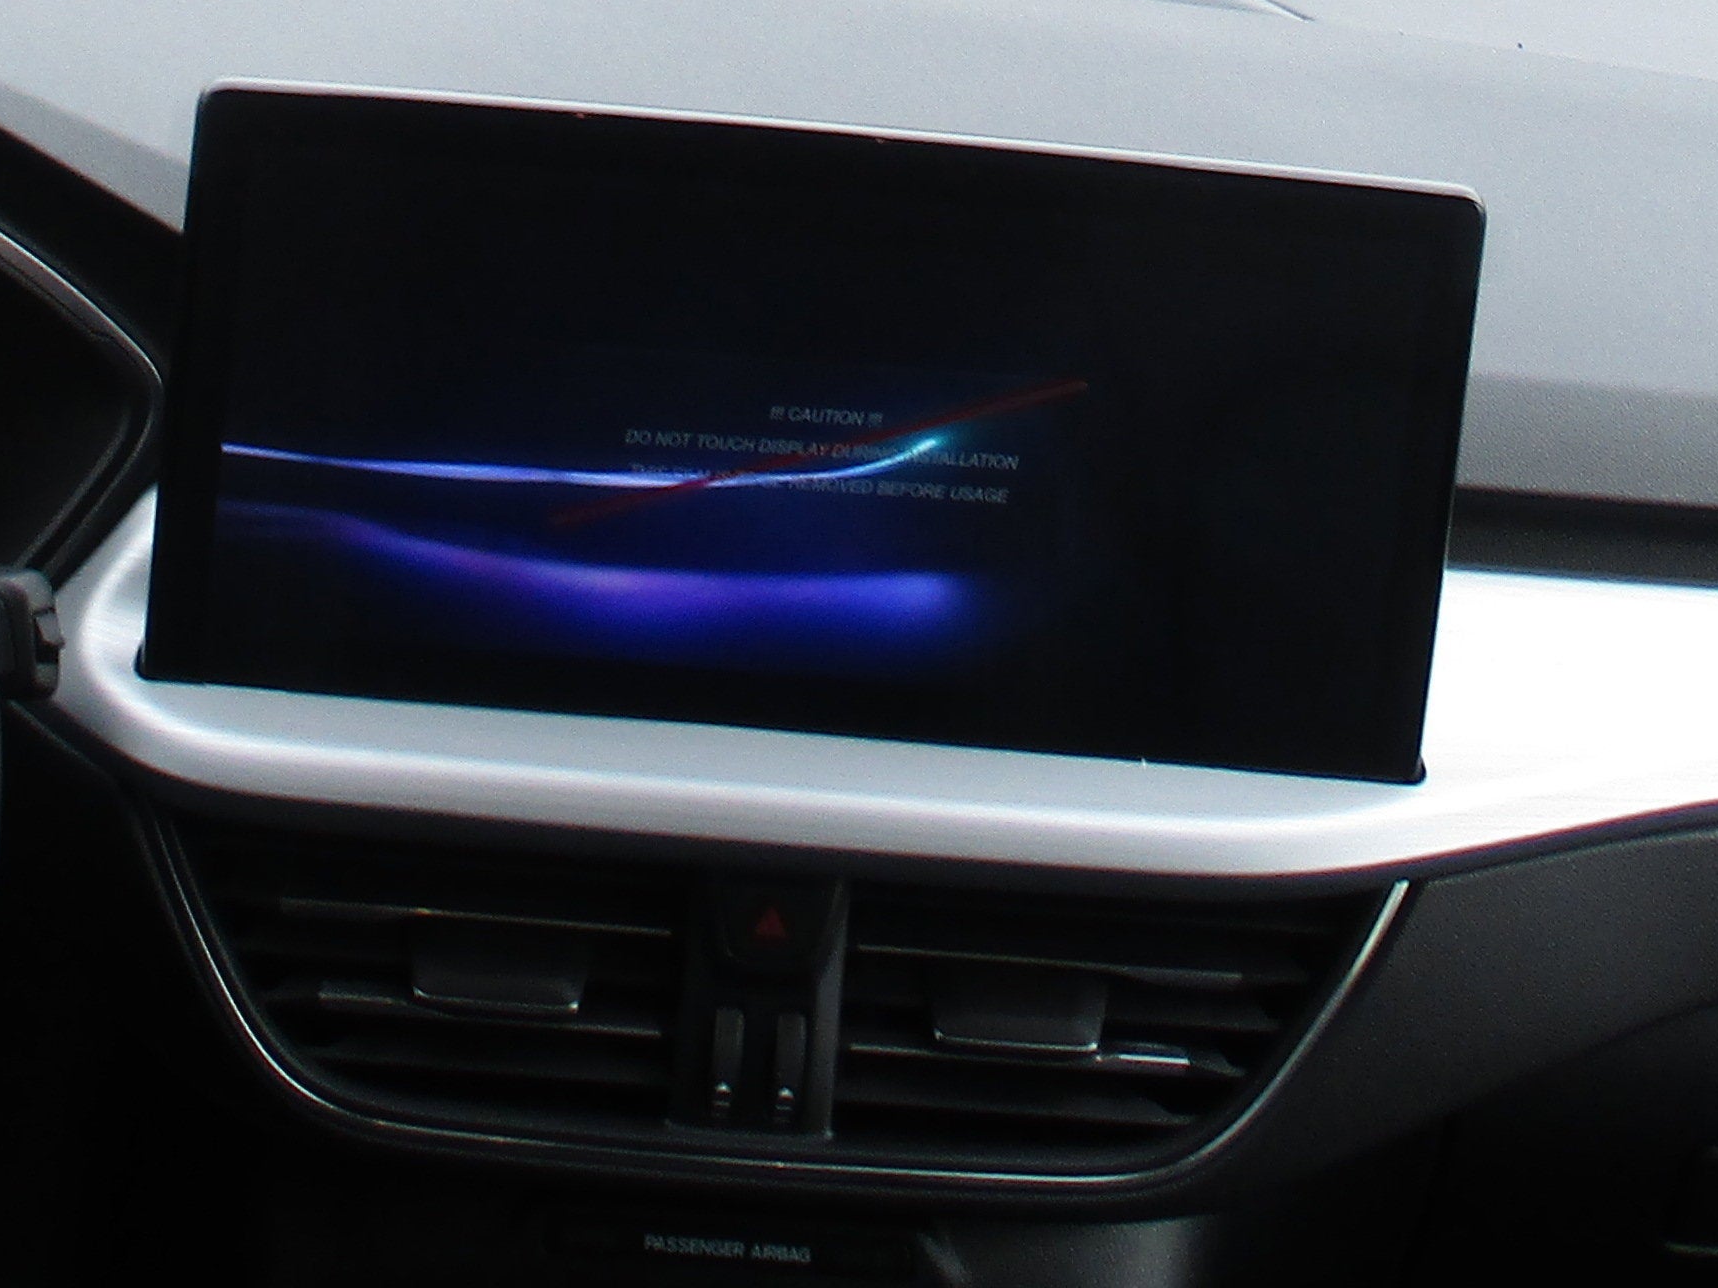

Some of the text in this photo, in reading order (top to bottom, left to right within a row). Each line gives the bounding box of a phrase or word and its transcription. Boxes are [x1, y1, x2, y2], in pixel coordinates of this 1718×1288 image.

[787, 406, 865, 426] CAUTION
[624, 427, 652, 445] DO
[655, 430, 692, 449] NOT
[697, 432, 755, 454] TOUCH
[756, 436, 830, 457] DISPLAY
[875, 480, 948, 500] BEFORE
[950, 485, 1011, 505] USAGE
[643, 1231, 812, 1263] PASSENGER AIRBAG
